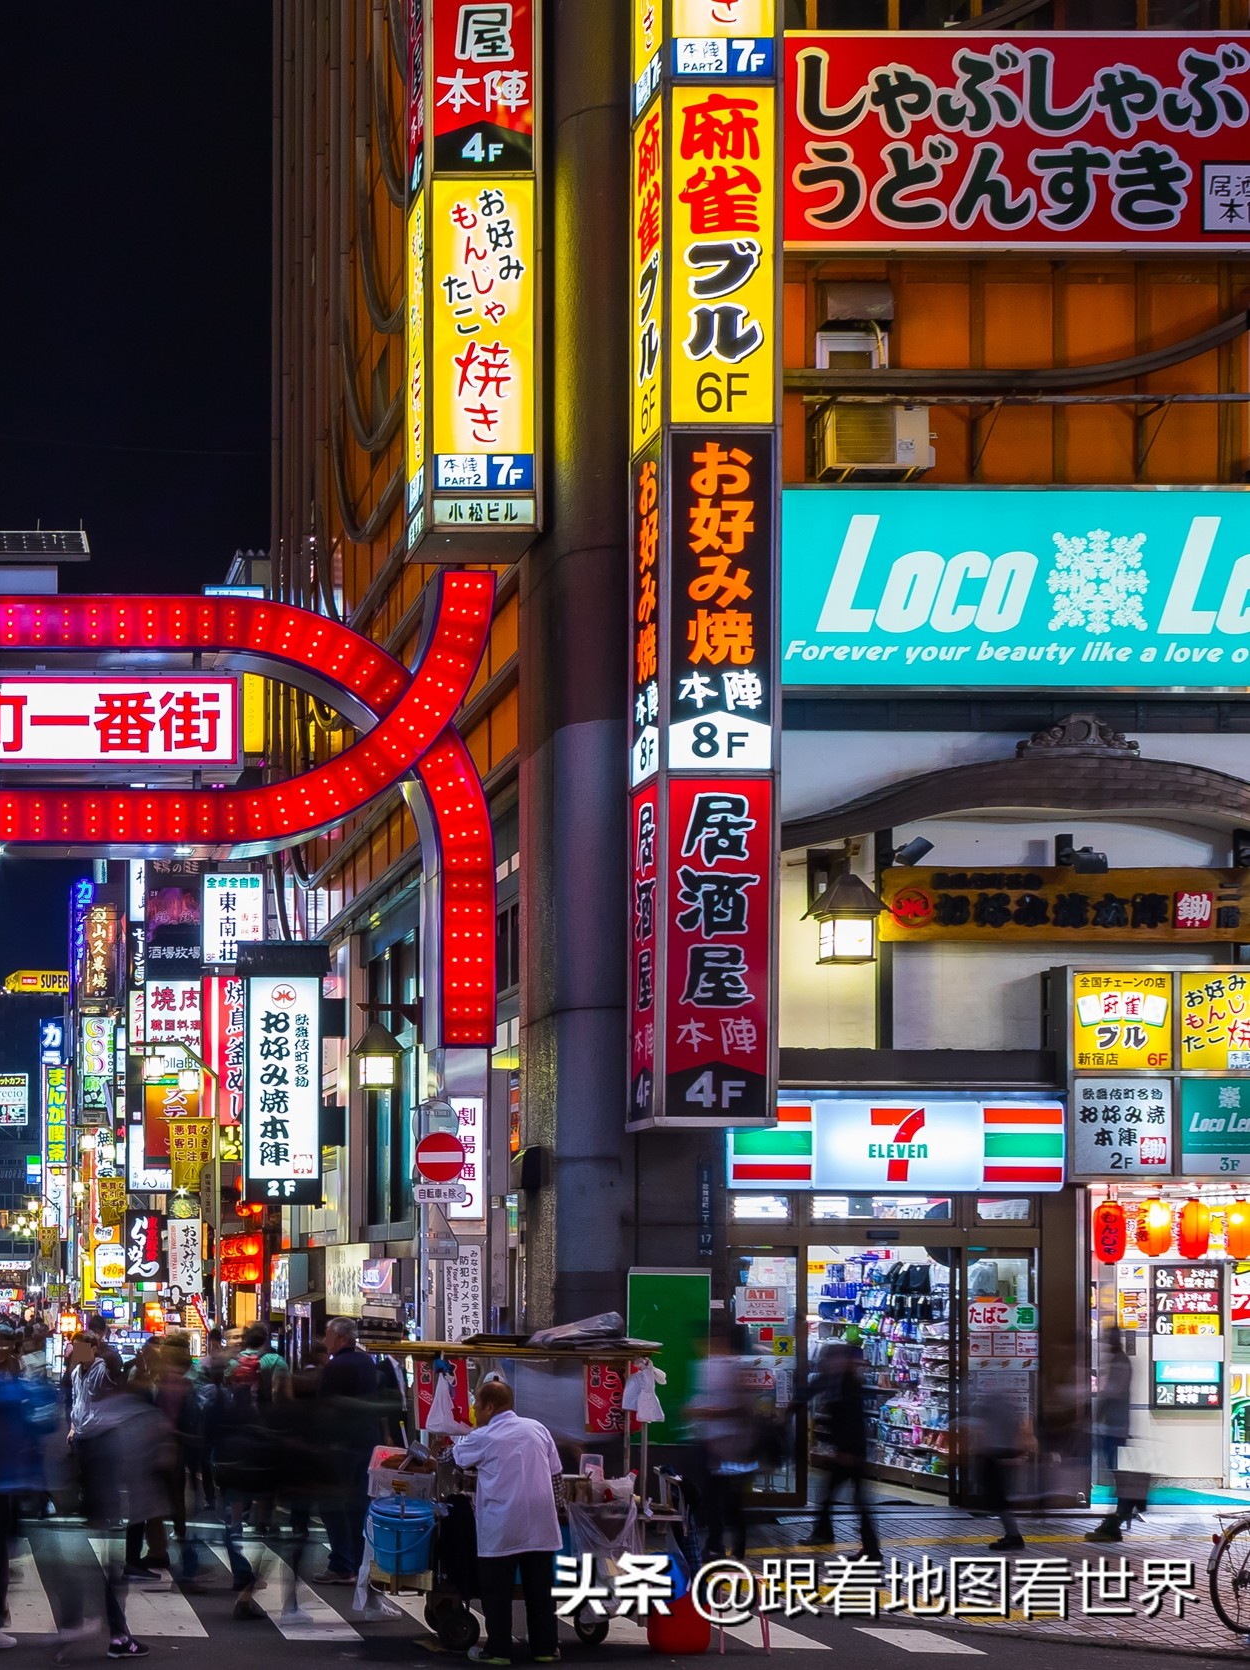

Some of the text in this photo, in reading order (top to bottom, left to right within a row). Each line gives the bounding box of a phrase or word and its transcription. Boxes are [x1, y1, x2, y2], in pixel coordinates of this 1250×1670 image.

[683, 59, 724, 72] PART2
[732, 40, 766, 72] 7F
[436, 68, 530, 114] 本陣
[795, 43, 1250, 138] しゃぶしゃぶ
[462, 132, 504, 163] 4F
[792, 134, 1193, 232] うどんすき
[1218, 200, 1250, 224] 本
[478, 189, 526, 281] お好み
[679, 93, 764, 364] 麻雀ブル
[451, 203, 506, 324] もんじゃ
[696, 373, 750, 413] 6F
[444, 474, 482, 486] PART2
[492, 455, 524, 486] 7F
[449, 502, 519, 522] 小松ビル
[687, 442, 756, 665] お好み焼
[784, 640, 900, 662] Forever
[905, 645, 970, 665] your
[977, 641, 1075, 666] beauty
[1082, 641, 1134, 663] like
[1140, 648, 1158, 663] a
[1164, 642, 1223, 664] love
[679, 668, 763, 711] 本陣
[691, 721, 749, 759] 8F
[206, 877, 260, 889] 全卓全自動
[676, 792, 761, 1009] 居酒屋
[219, 891, 238, 962] 東南荘
[41, 974, 68, 989] SUPER
[1080, 976, 1166, 989] 全国チェーンの店
[1184, 975, 1247, 1008] お好み
[151, 986, 201, 1012] 焼肉
[1103, 994, 1141, 1015] 麻雀
[676, 1016, 758, 1055] 本陣
[1096, 1026, 1146, 1048] ブル
[294, 1014, 309, 1088] 歌舞伎町名物
[1078, 1052, 1168, 1066] 新宿店 6F
[259, 1010, 291, 1167] お好み焼本陣
[685, 1070, 746, 1109] 4F
[1082, 1088, 1163, 1100] 歌舞伎町名物
[47, 1068, 67, 1163] まんが喫茶
[1079, 1105, 1166, 1125] お好み焼
[173, 1124, 210, 1136] 悪質な
[1094, 1128, 1138, 1147] 本陣
[173, 1138, 210, 1150] 客引き
[173, 1151, 210, 1163] に注意
[1110, 1152, 1133, 1169] 2F
[1219, 1157, 1241, 1171] 3F
[267, 1180, 296, 1198] 2F
[418, 1188, 463, 1200] 自転車を除く
[180, 1225, 201, 1286] お好み焼き
[445, 1266, 453, 1291] Security
[1156, 1269, 1174, 1288] 8F
[459, 1255, 472, 1337] 防犯カメラ作動
[747, 1289, 776, 1300] ATM
[1155, 1292, 1174, 1312] 7F
[968, 1306, 1035, 1325] たばこ 酒
[1155, 1315, 1173, 1335] 6F
[1156, 1385, 1175, 1404] 2F
